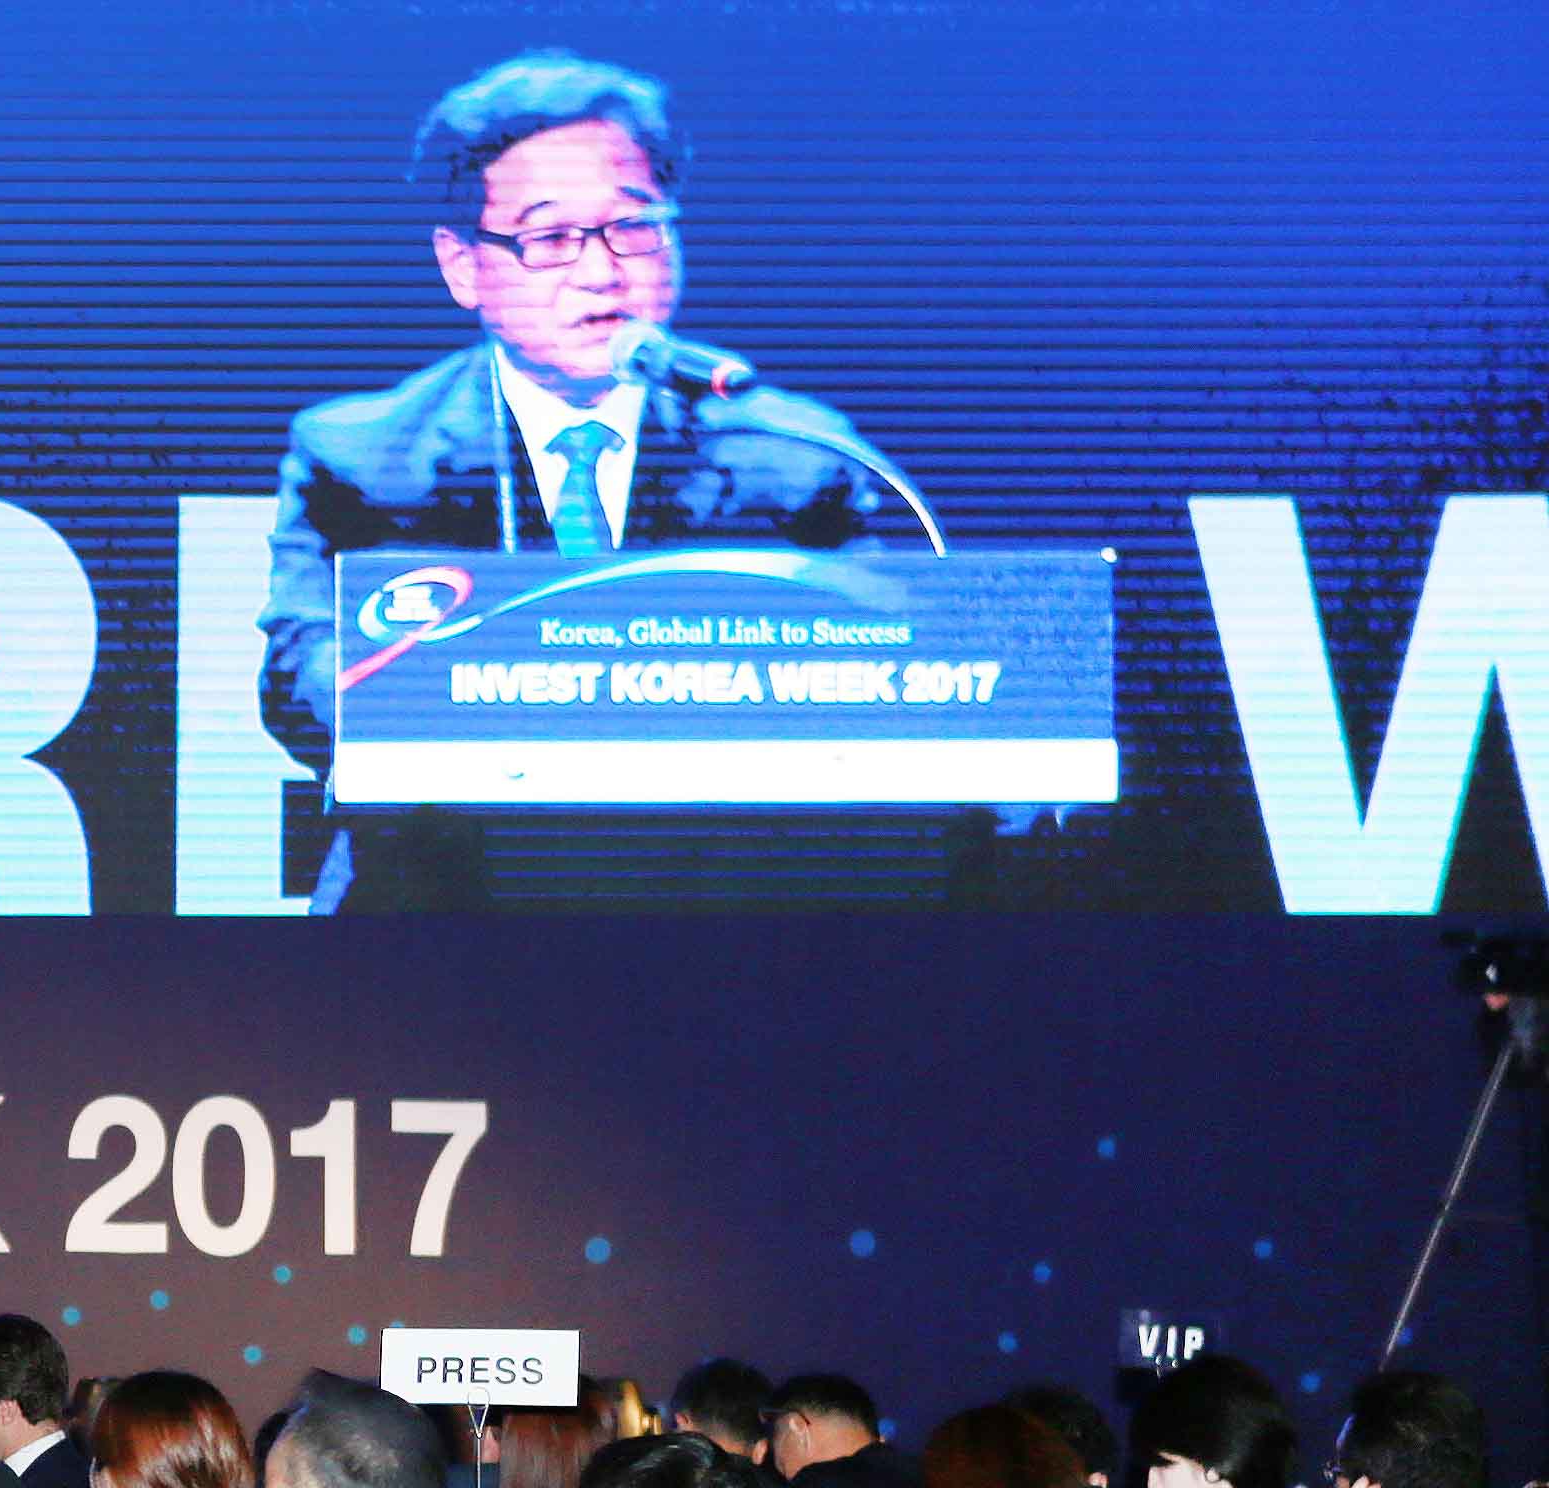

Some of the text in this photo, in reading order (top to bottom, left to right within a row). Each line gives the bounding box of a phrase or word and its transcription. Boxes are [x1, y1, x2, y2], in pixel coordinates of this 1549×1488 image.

[540, 617, 912, 649] Korea, Global Link to Success
[450, 660, 1001, 706] INVEST KOREA WEEK 2017
[63, 1094, 489, 1258] 2017
[1138, 1323, 1205, 1360] VIP
[416, 1356, 544, 1385] PRESS
